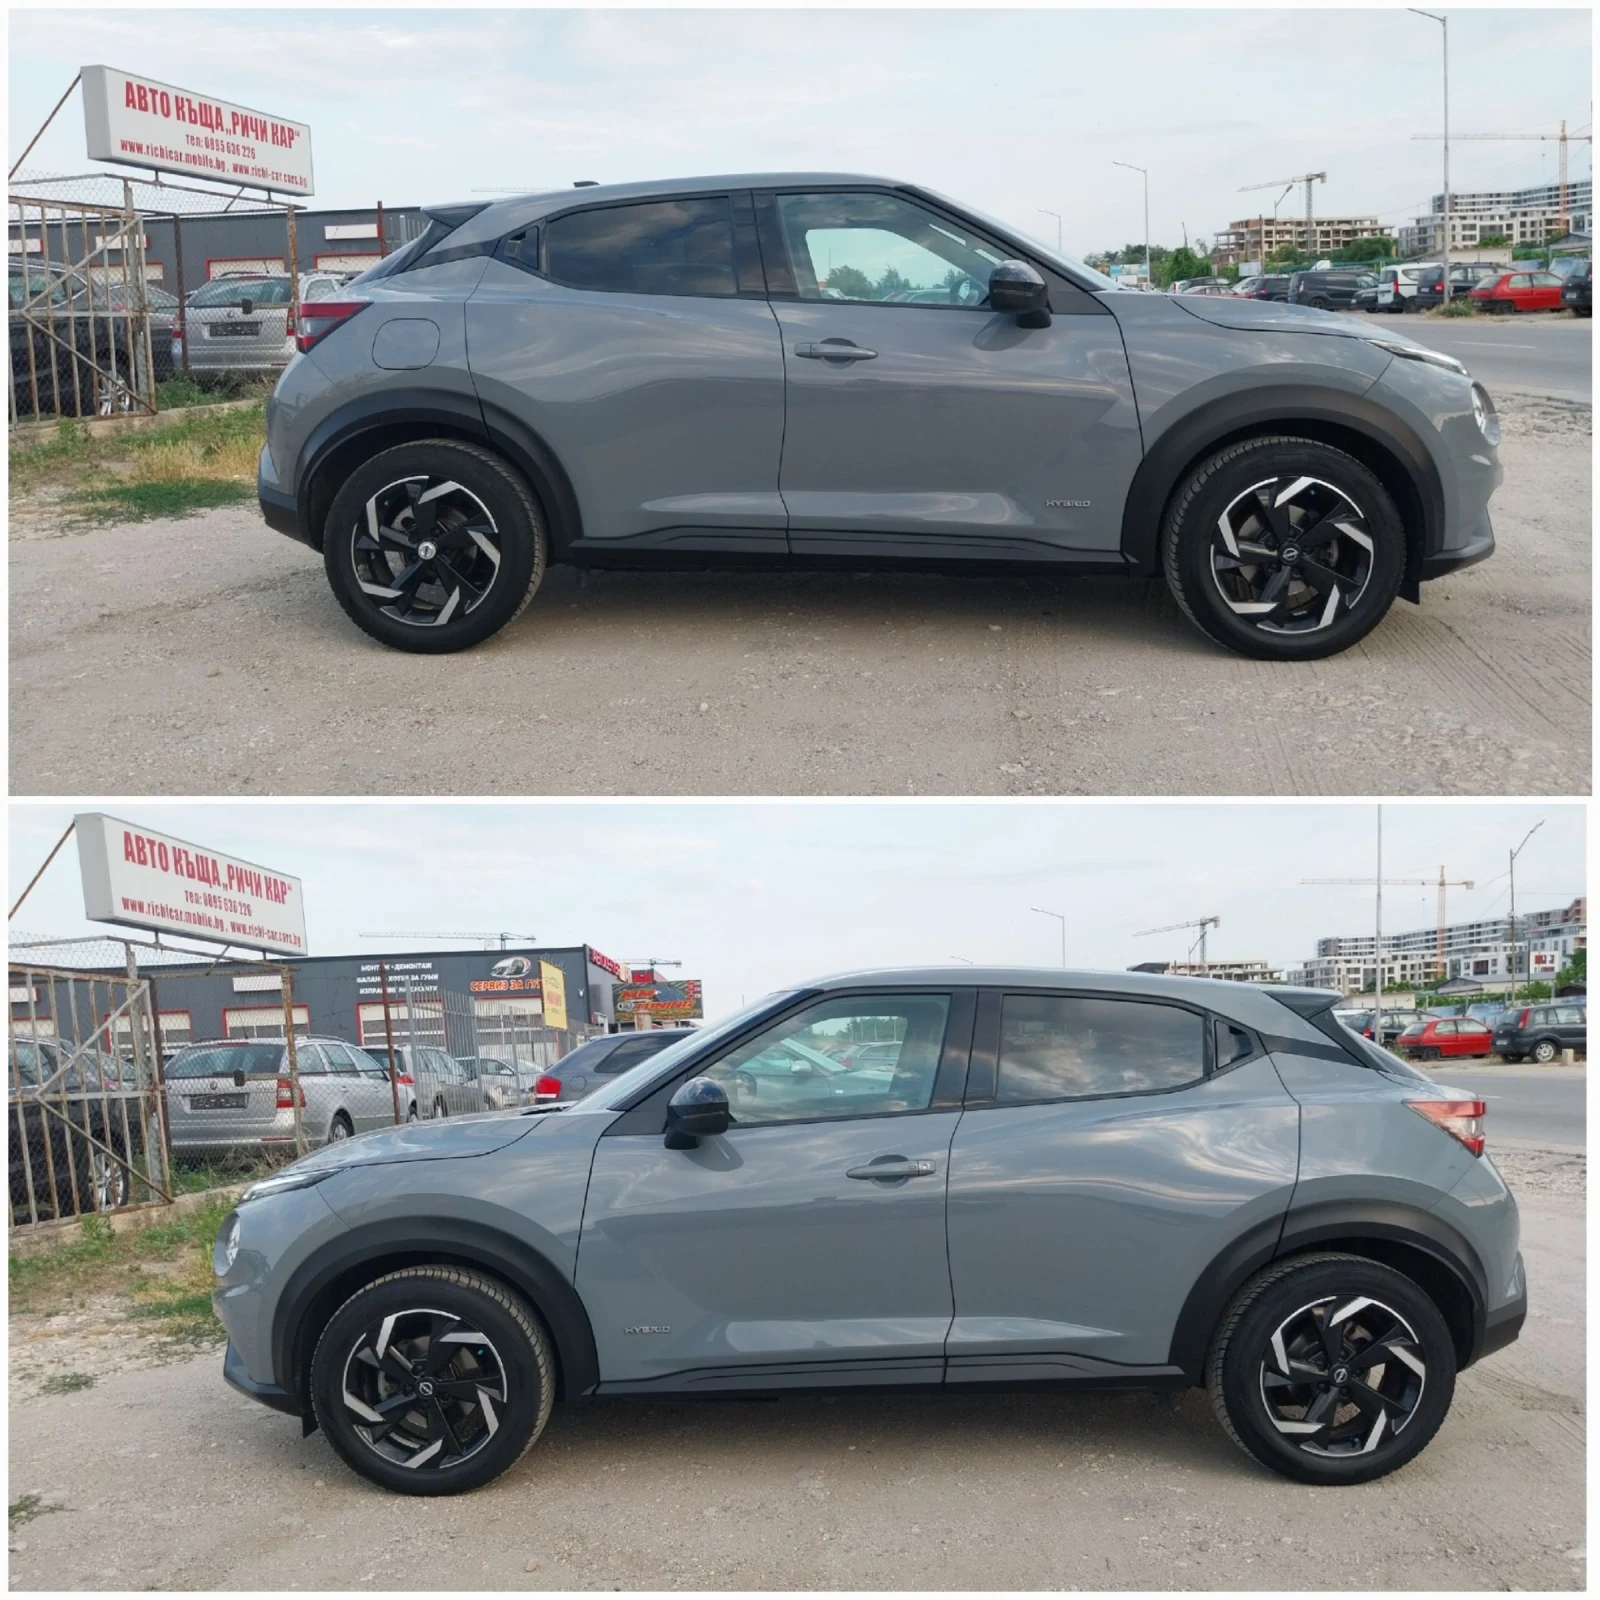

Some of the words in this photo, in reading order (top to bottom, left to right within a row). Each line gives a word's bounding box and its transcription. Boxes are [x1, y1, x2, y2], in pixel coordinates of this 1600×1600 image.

[125, 80, 171, 119] АВТО
[174, 95, 224, 134] КЪЩА
[204, 136, 225, 153] 0895
[226, 141, 240, 157] 636
[241, 145, 256, 160] 226
[1045, 499, 1091, 508] HYBRID
[123, 830, 169, 873] АВТО
[172, 845, 221, 889] КЪЩА
[203, 892, 223, 911] 0895
[223, 897, 238, 914] 636
[238, 901, 253, 917] 226
[361, 964, 391, 972] МОНТЖ
[394, 962, 433, 971] ДЕМОНТАЖ
[420, 973, 439, 981] ГУМИ
[470, 980, 508, 992] СЕРВИЗ
[509, 979, 524, 991] ЗА
[624, 1325, 670, 1335] HYBRID
